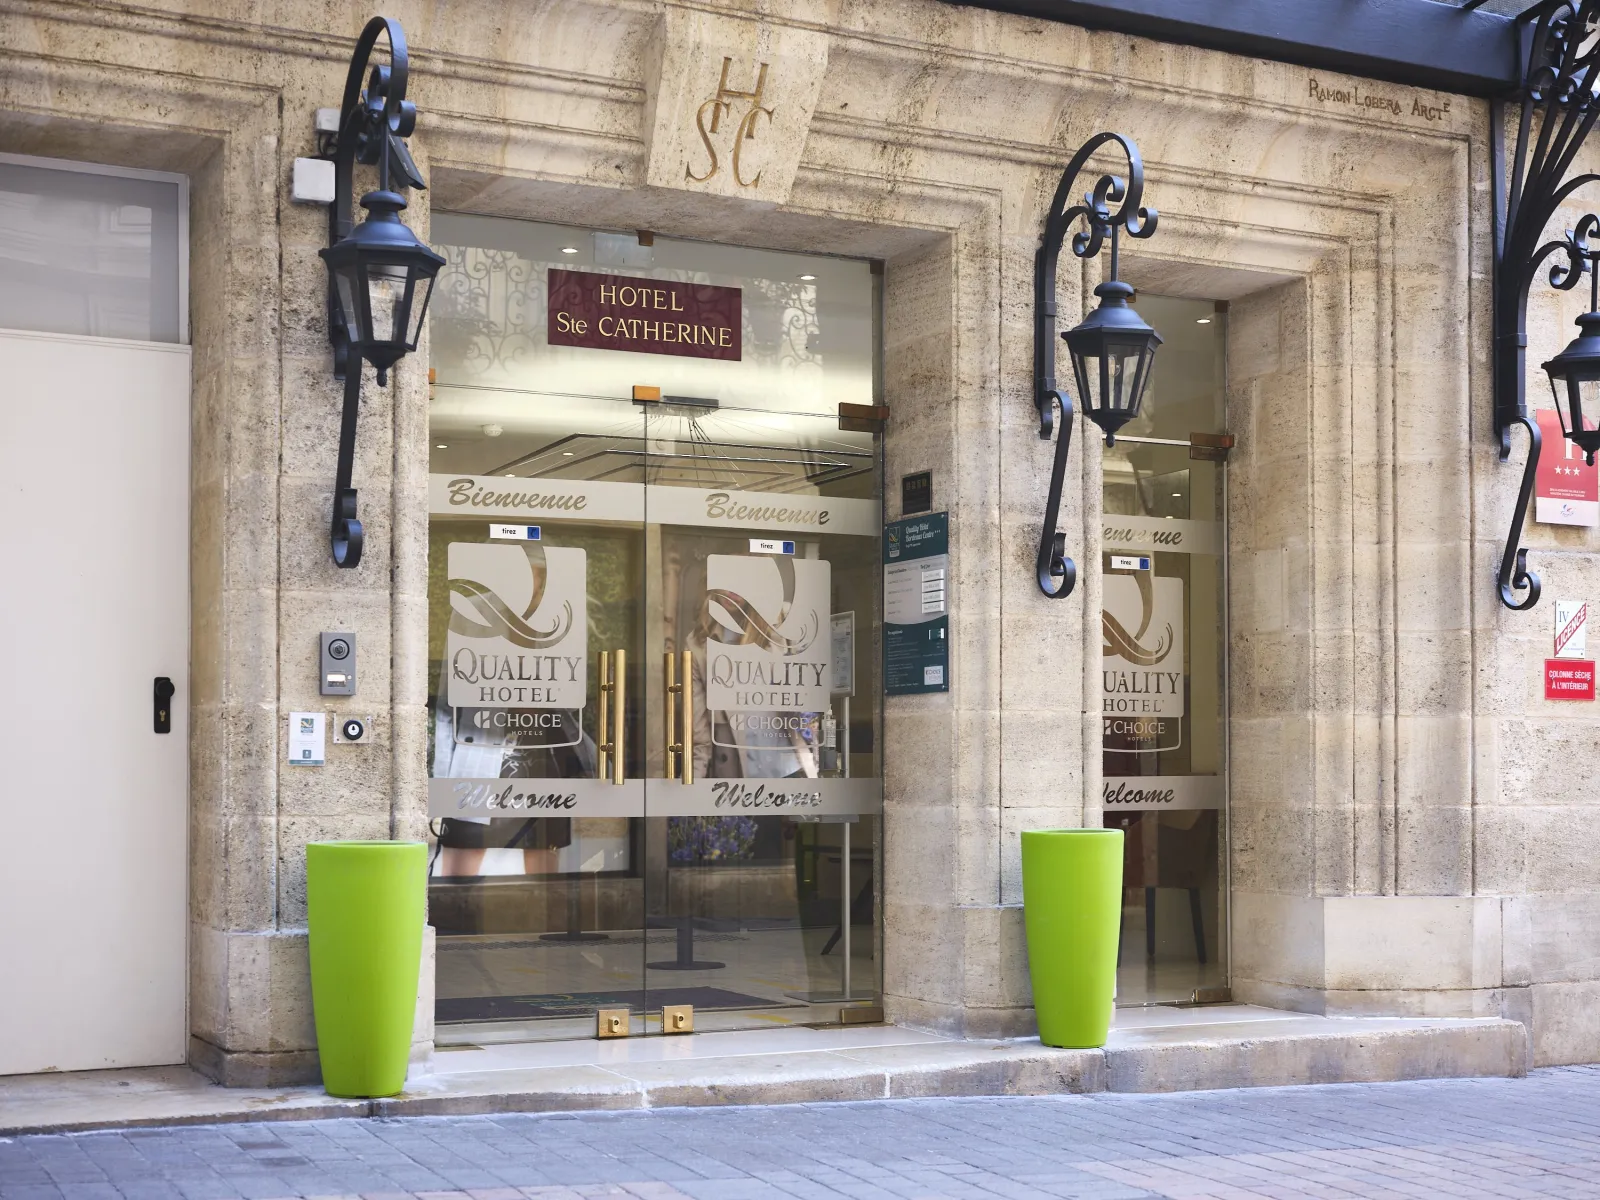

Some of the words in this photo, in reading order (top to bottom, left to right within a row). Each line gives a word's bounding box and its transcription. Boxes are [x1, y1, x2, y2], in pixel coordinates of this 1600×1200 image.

[600, 284, 684, 312] HOTEL
[556, 311, 588, 334] Ste
[598, 316, 732, 347] CATHERINE
[447, 478, 587, 511] Bienvenue
[705, 492, 830, 525] Bienvenue
[1558, 610, 1570, 623] IV
[1556, 606, 1585, 652] LICENCE
[453, 647, 582, 684] QUALITY
[712, 653, 826, 689] QUALITY
[1548, 669, 1574, 679] COLONNE
[1574, 669, 1592, 680] SÈCHE
[1102, 670, 1181, 694] UALITY
[1557, 680, 1588, 691] L'INTÉRIEUR
[479, 686, 557, 703] HOTEL
[735, 691, 804, 707] HOTEL
[1102, 698, 1162, 713] HOTEL
[493, 711, 562, 728] CHOICE
[747, 714, 809, 730] CHOICE
[1113, 720, 1166, 735] CHOICE
[453, 781, 578, 810] Welcome
[711, 781, 822, 808] Welcome
[1102, 781, 1175, 804] elcome
